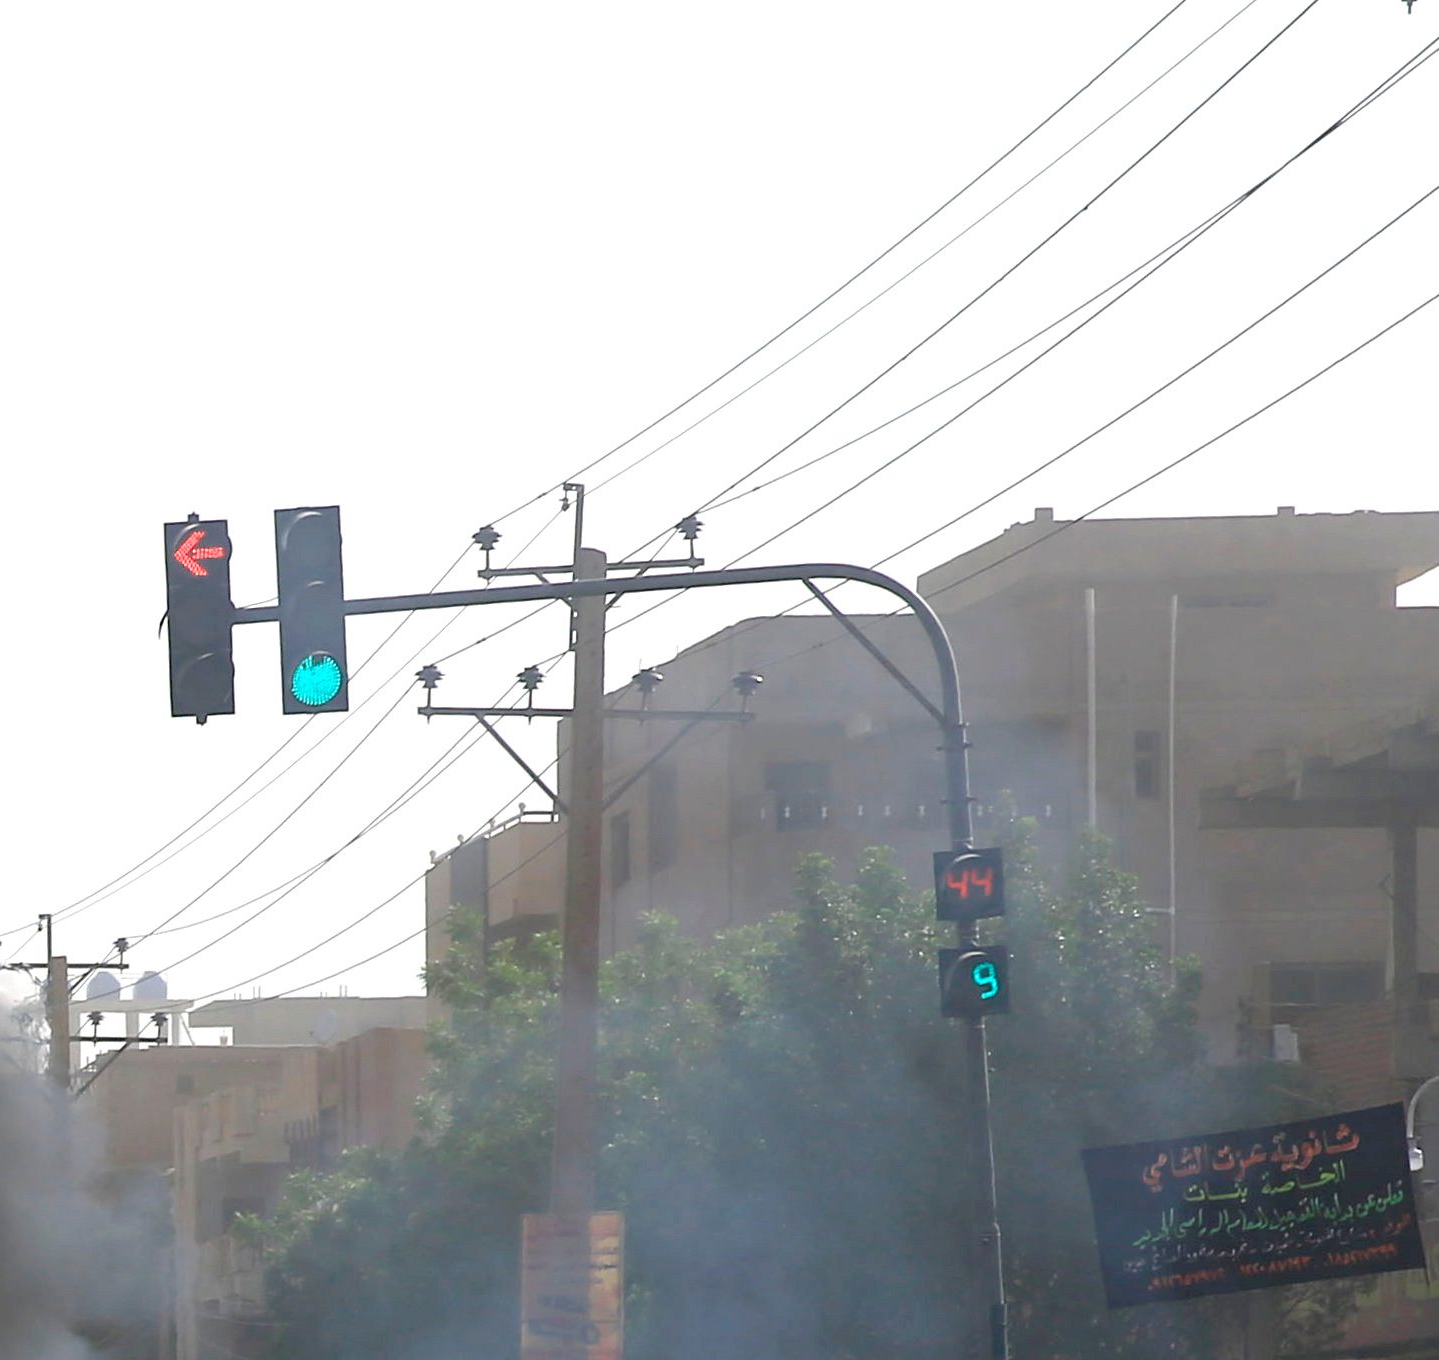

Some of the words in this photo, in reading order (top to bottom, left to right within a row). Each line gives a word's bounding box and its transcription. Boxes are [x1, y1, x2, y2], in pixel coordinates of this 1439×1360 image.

[946, 868, 993, 899] 44
[973, 962, 999, 999] 9
[1272, 1123, 1360, 1172] ثانوية
[1184, 1181, 1248, 1203] بنات
[1261, 1159, 1345, 1195] الخاصة
